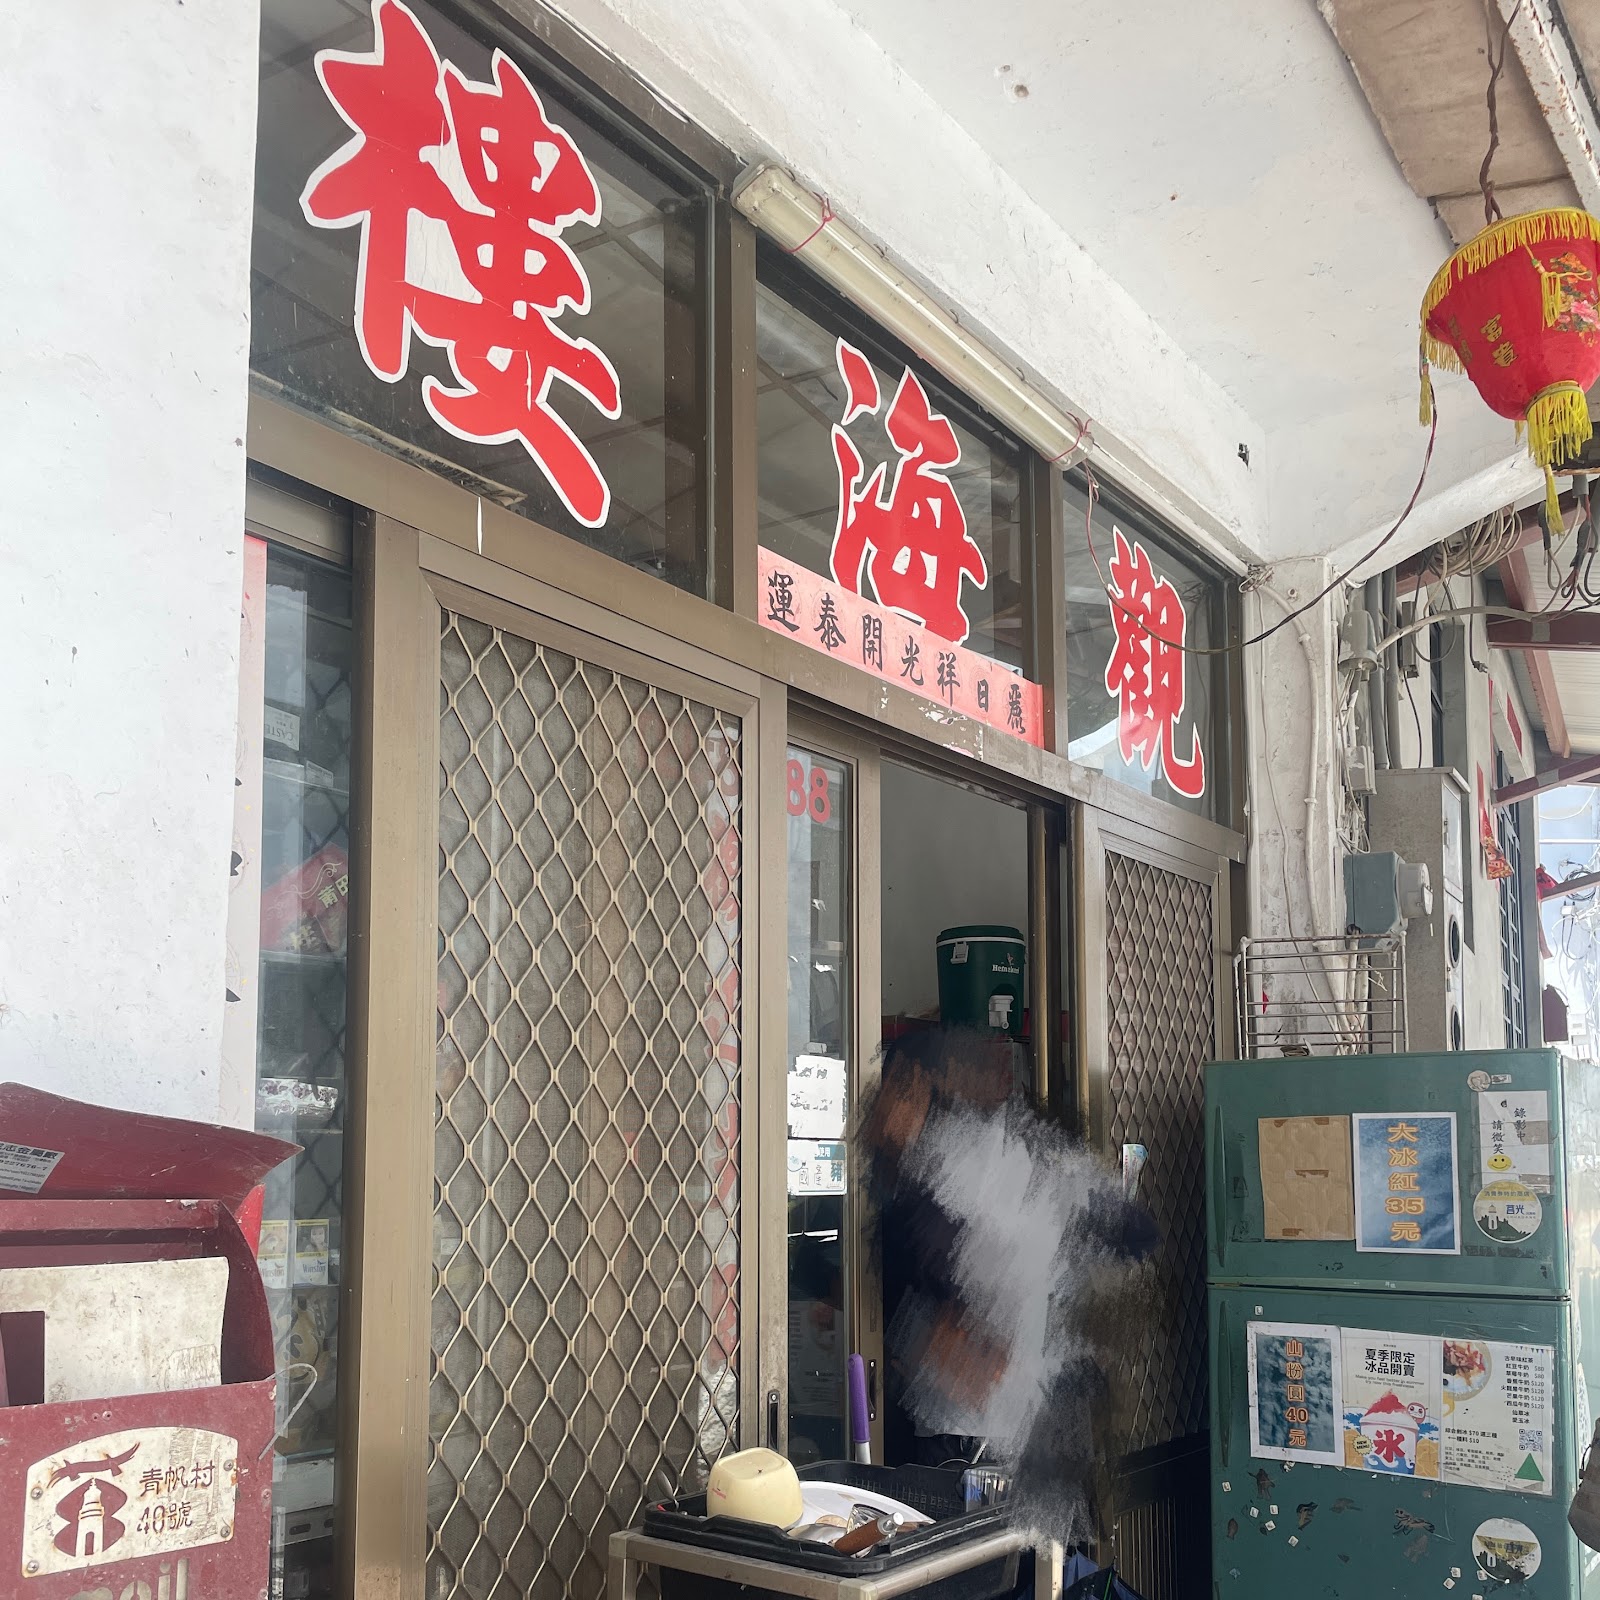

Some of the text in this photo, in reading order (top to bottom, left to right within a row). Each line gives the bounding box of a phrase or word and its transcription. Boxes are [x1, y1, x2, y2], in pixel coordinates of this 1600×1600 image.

[1365, 1348, 1416, 1365] 夏季限定
[1365, 1360, 1416, 1378] 冰品開賣
[140, 1460, 216, 1497] 青帆村
